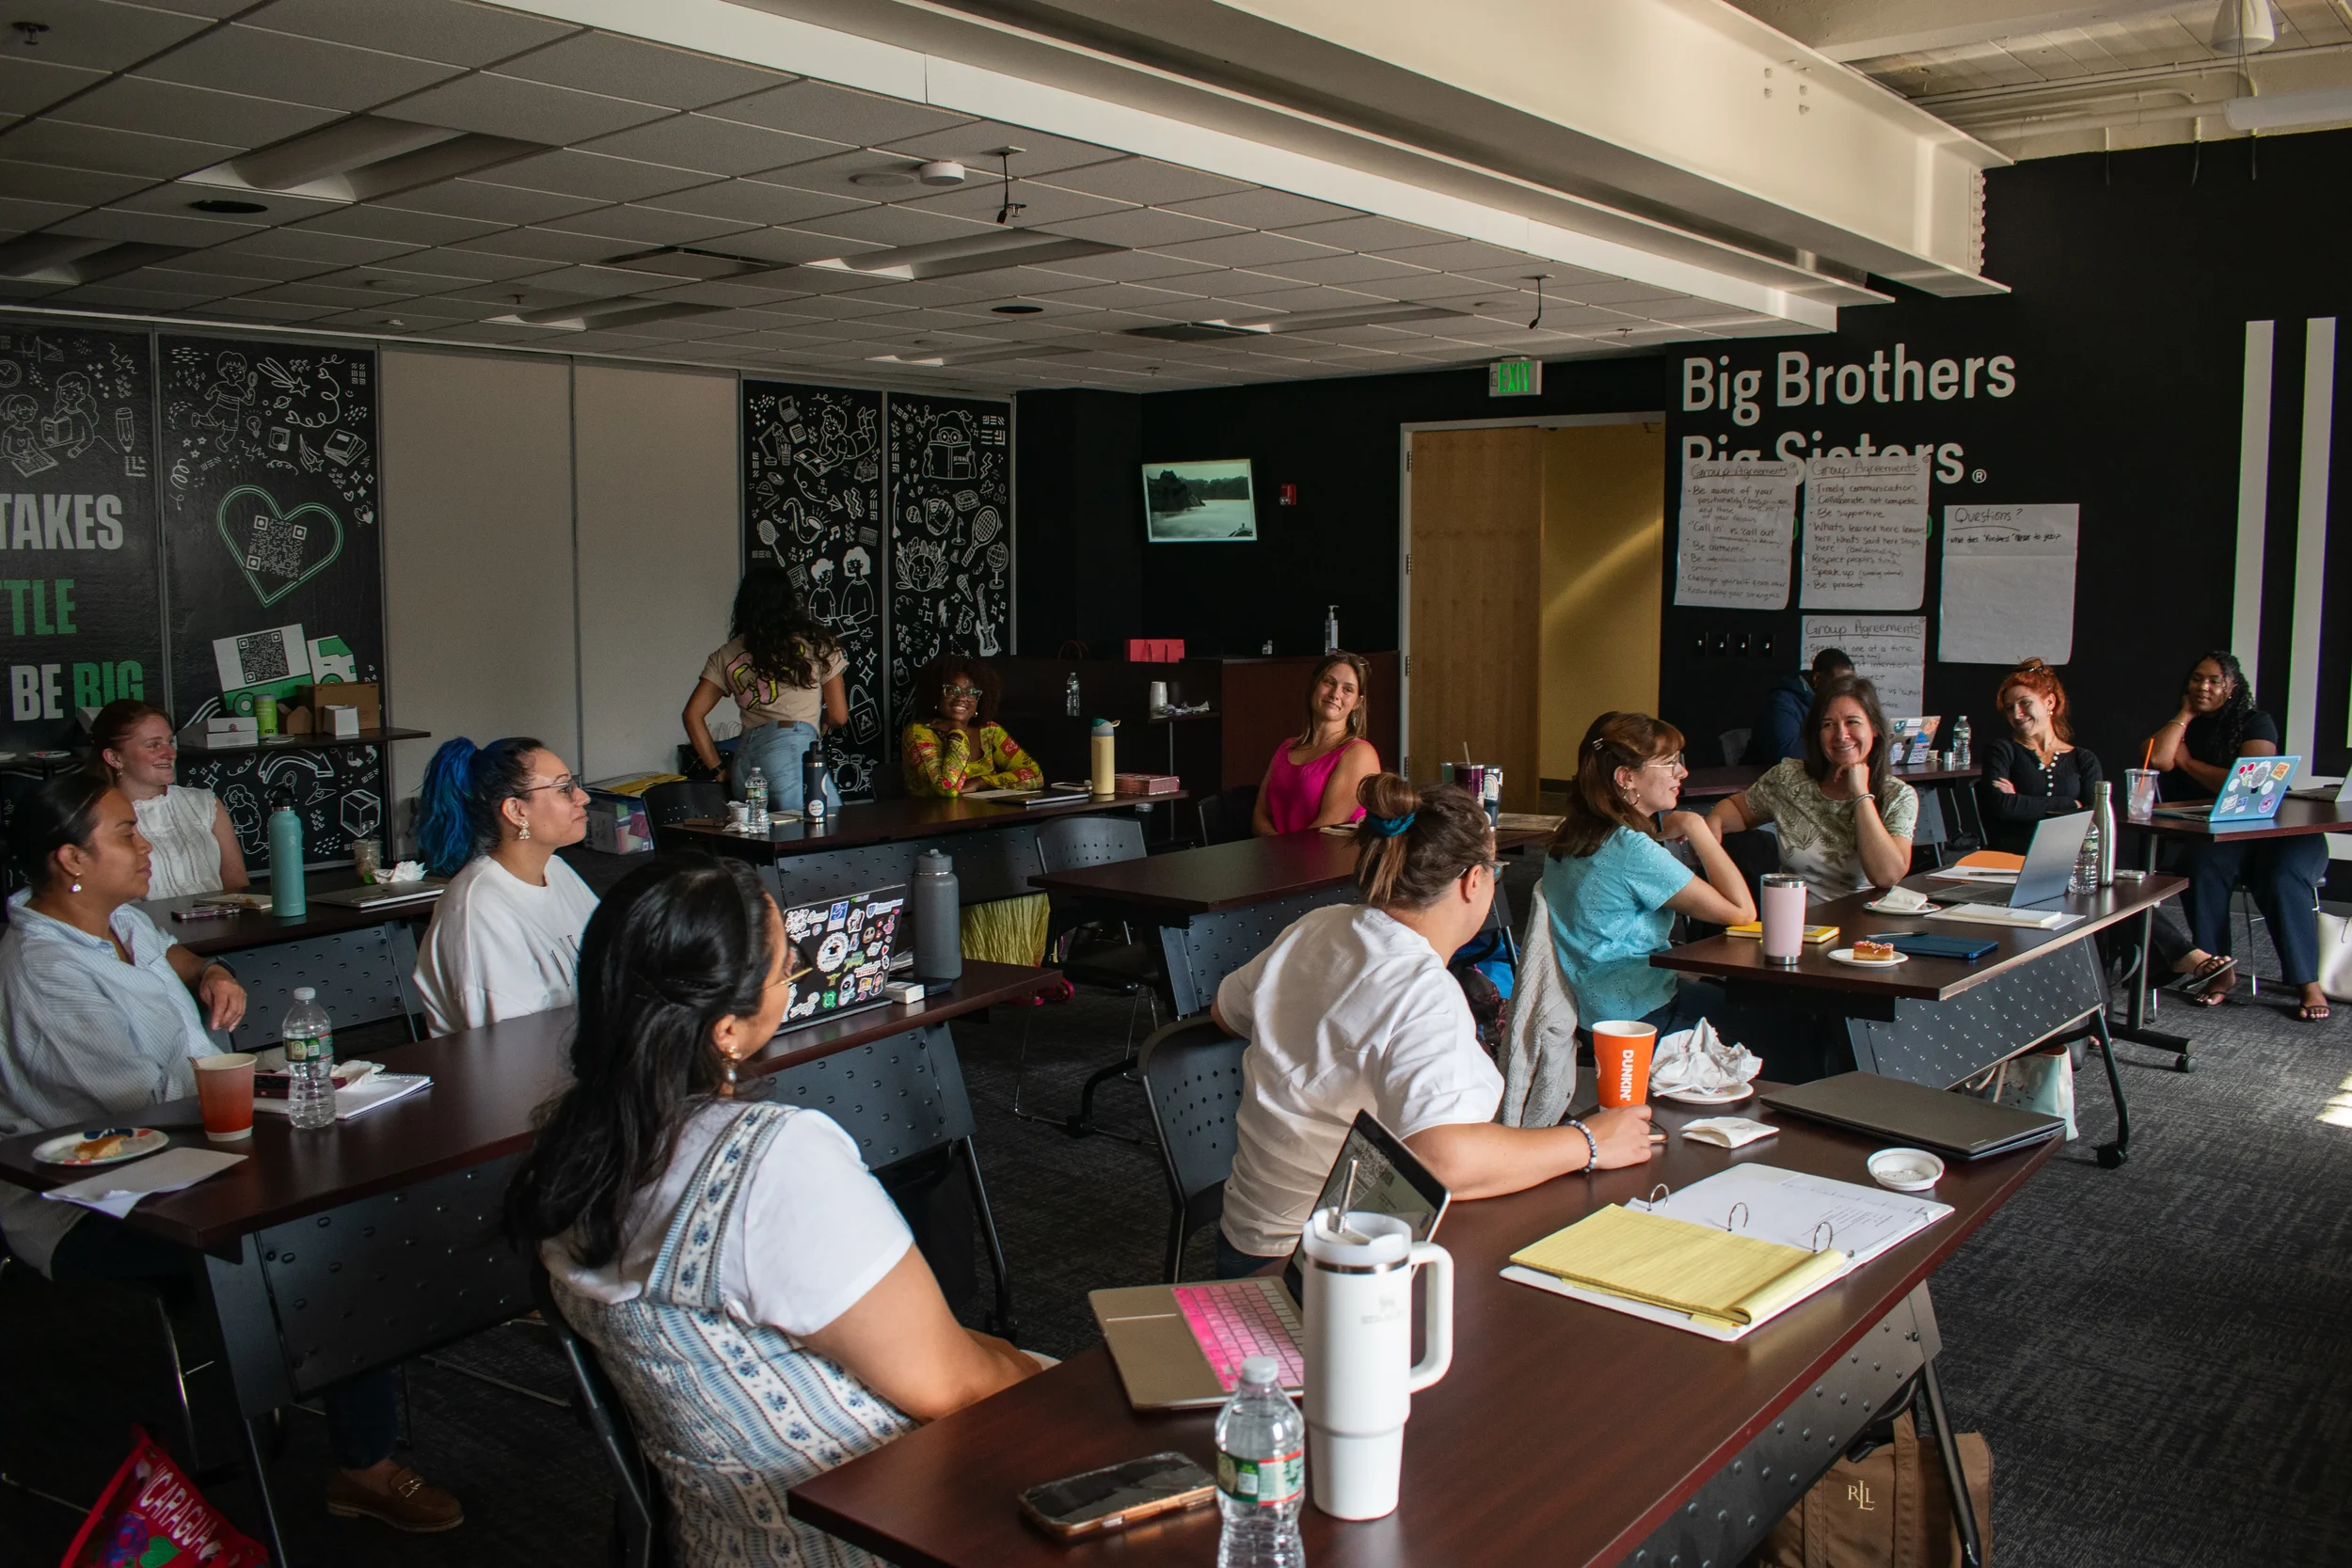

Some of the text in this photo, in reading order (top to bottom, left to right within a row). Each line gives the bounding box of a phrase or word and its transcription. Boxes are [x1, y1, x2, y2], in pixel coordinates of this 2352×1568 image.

[1498, 362, 1532, 392] EXIT
[1682, 342, 2017, 427] Big Brothers
[1692, 464, 1729, 479] Group
[1735, 465, 1788, 479] Agreements
[1812, 460, 1851, 479] Group
[1855, 459, 1920, 477] Agreements
[1692, 485, 1707, 495] Be
[1740, 485, 1750, 495] of
[1755, 488, 1773, 498] your
[1816, 483, 1916, 497] Timely communication
[1818, 496, 1865, 505] Collaborate
[1884, 498, 1917, 506] compete
[1817, 508, 1832, 518] Be
[1954, 507, 2011, 524] Questions
[1849, 524, 1876, 532] learned
[1880, 524, 1899, 532] here
[1812, 554, 1844, 565] Respect
[1814, 579, 1827, 589] Be
[0, 578, 77, 636] TLE
[1805, 619, 1922, 641] Group Agreements
[9, 659, 144, 721] BE BIG
[1619, 1049, 1634, 1101] DUNKIN'
